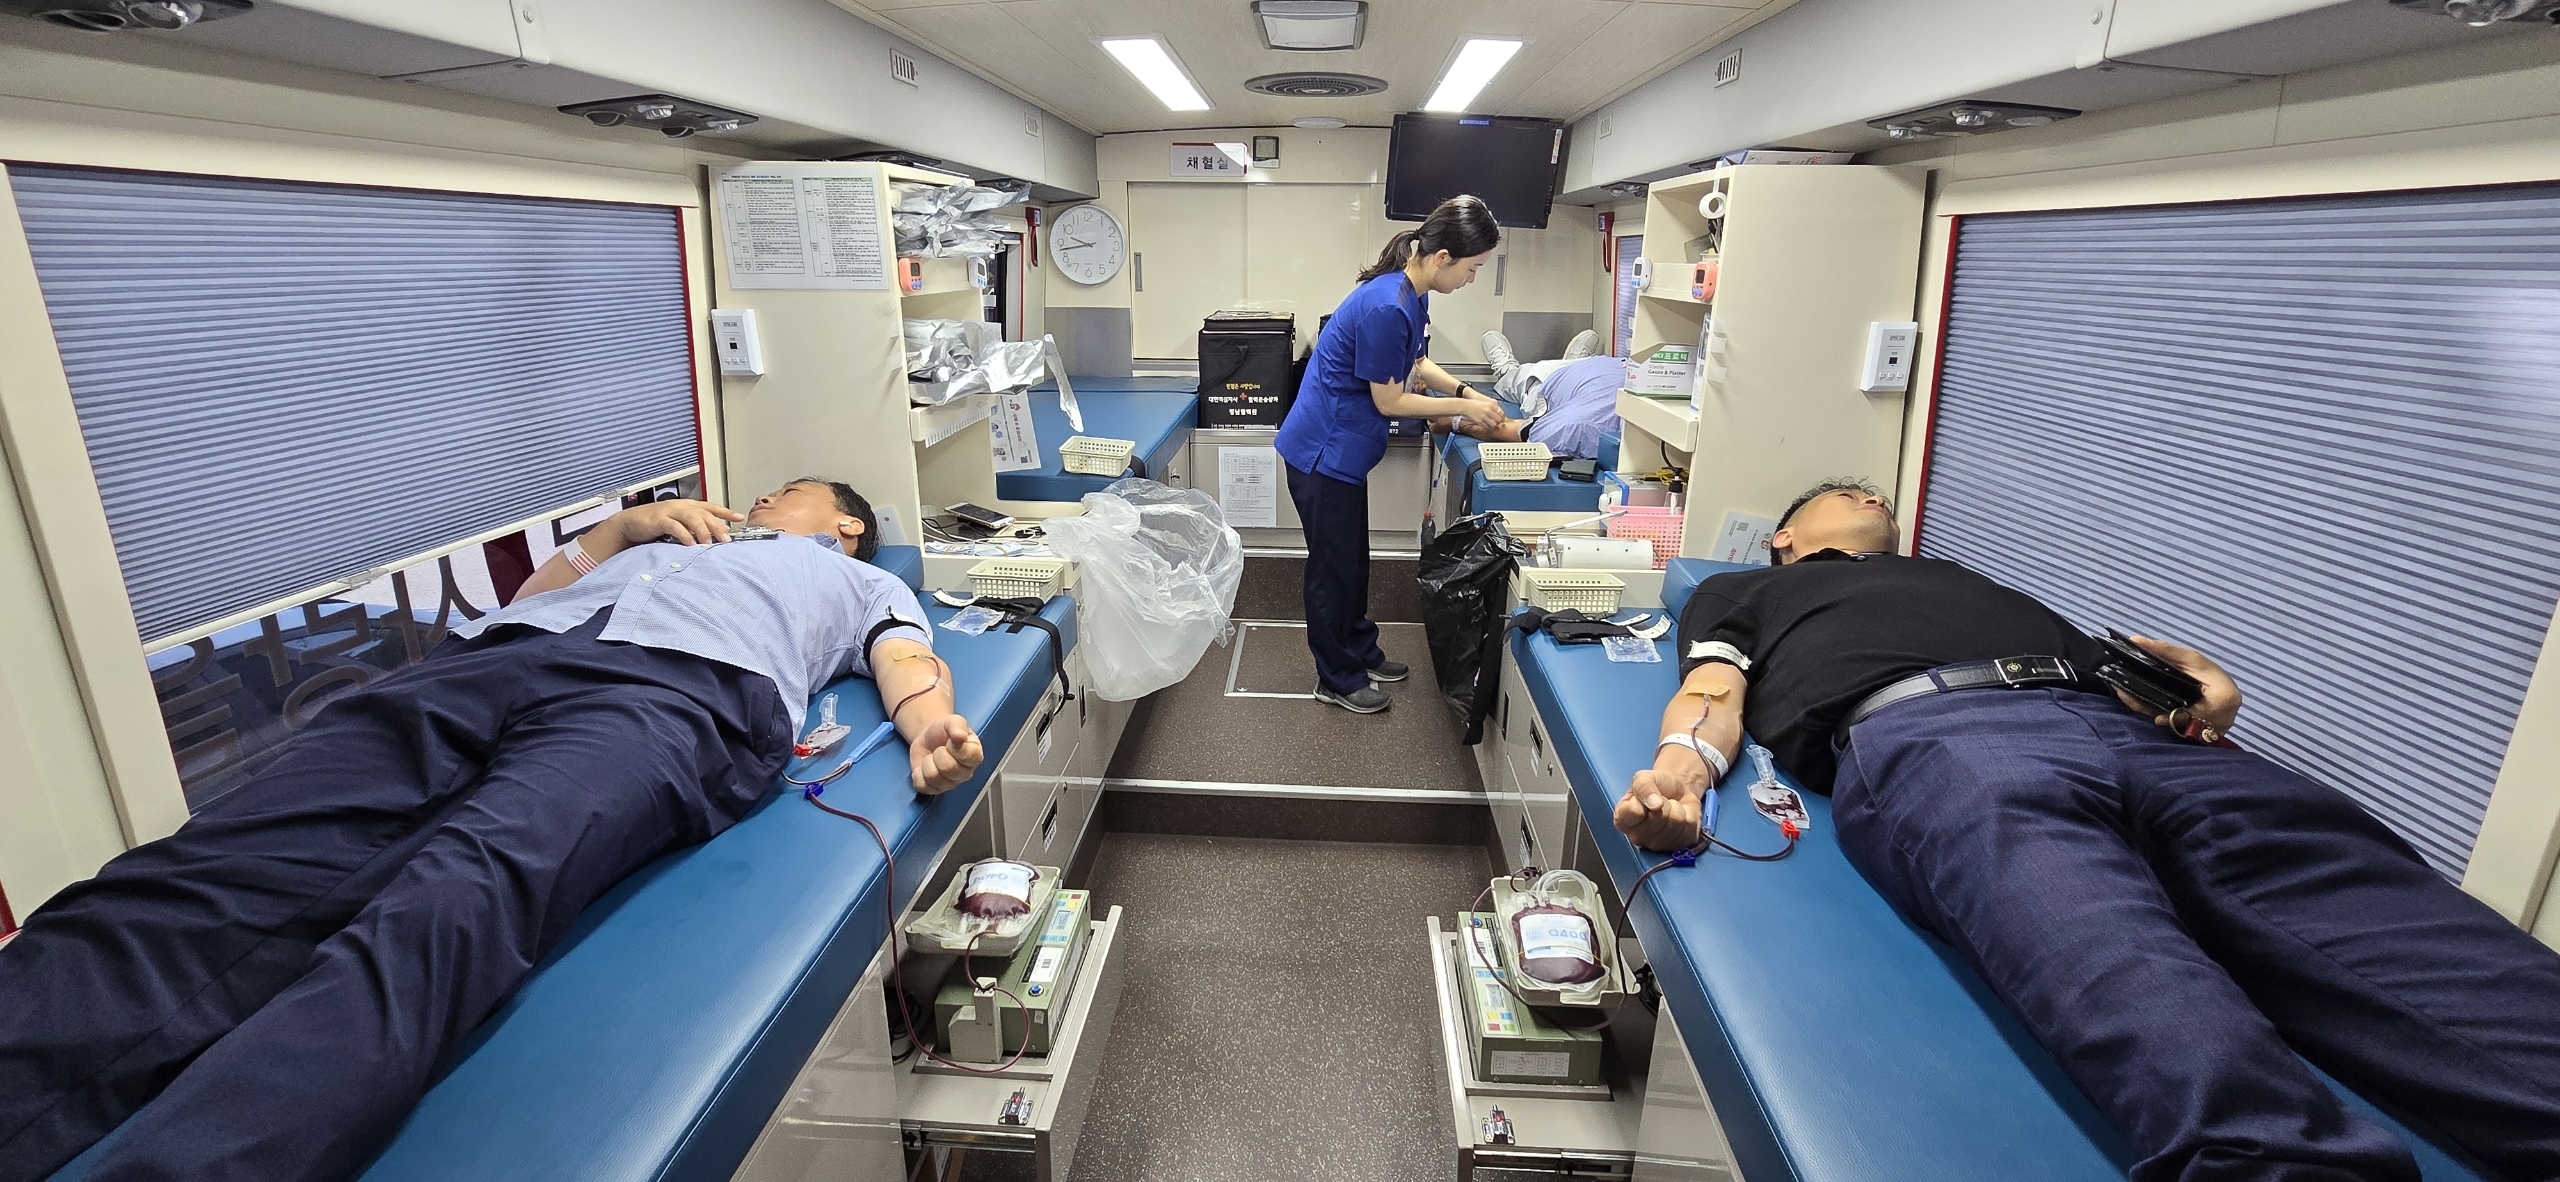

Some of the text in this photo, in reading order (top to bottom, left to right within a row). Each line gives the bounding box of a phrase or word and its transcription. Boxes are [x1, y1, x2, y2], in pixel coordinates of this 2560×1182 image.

[1186, 156, 1229, 170] 채혈실
[1072, 214, 1080, 226] 11
[1083, 211, 1093, 222] 12
[1100, 215, 1103, 227] 1
[1062, 223, 1074, 235] 10
[1108, 226, 1116, 238] 2
[1057, 238, 1064, 248] 9
[1113, 240, 1120, 252] 3
[1062, 252, 1069, 263] 8
[1108, 254, 1115, 265] 4
[1073, 263, 1079, 273] 7
[1085, 267, 1092, 278] 6
[1098, 264, 1106, 275] 5
[1548, 928, 1587, 941] Q400
